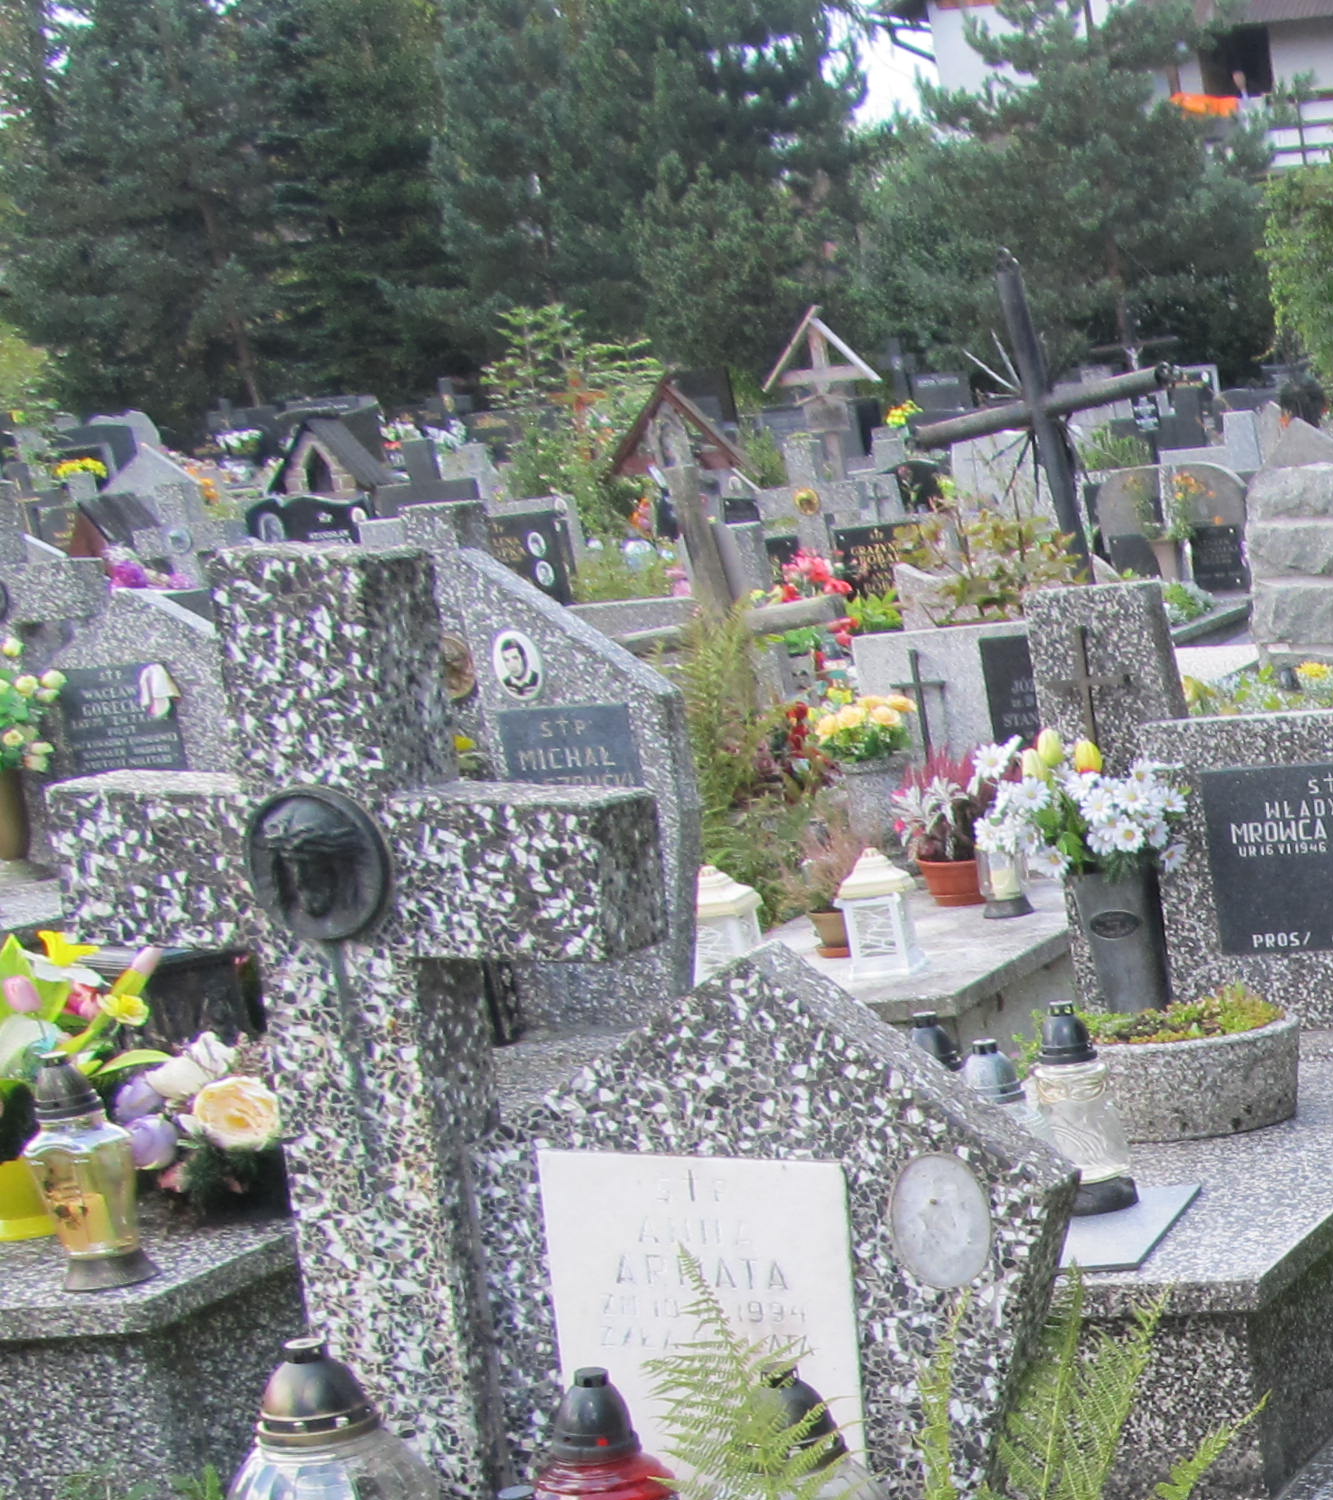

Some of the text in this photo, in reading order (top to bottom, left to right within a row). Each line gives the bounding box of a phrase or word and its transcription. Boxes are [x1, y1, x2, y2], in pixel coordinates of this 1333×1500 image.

[518, 745, 617, 772] MICHAŁ
[1230, 818, 1328, 845] MROWCA
[1294, 841, 1327, 855] 1946
